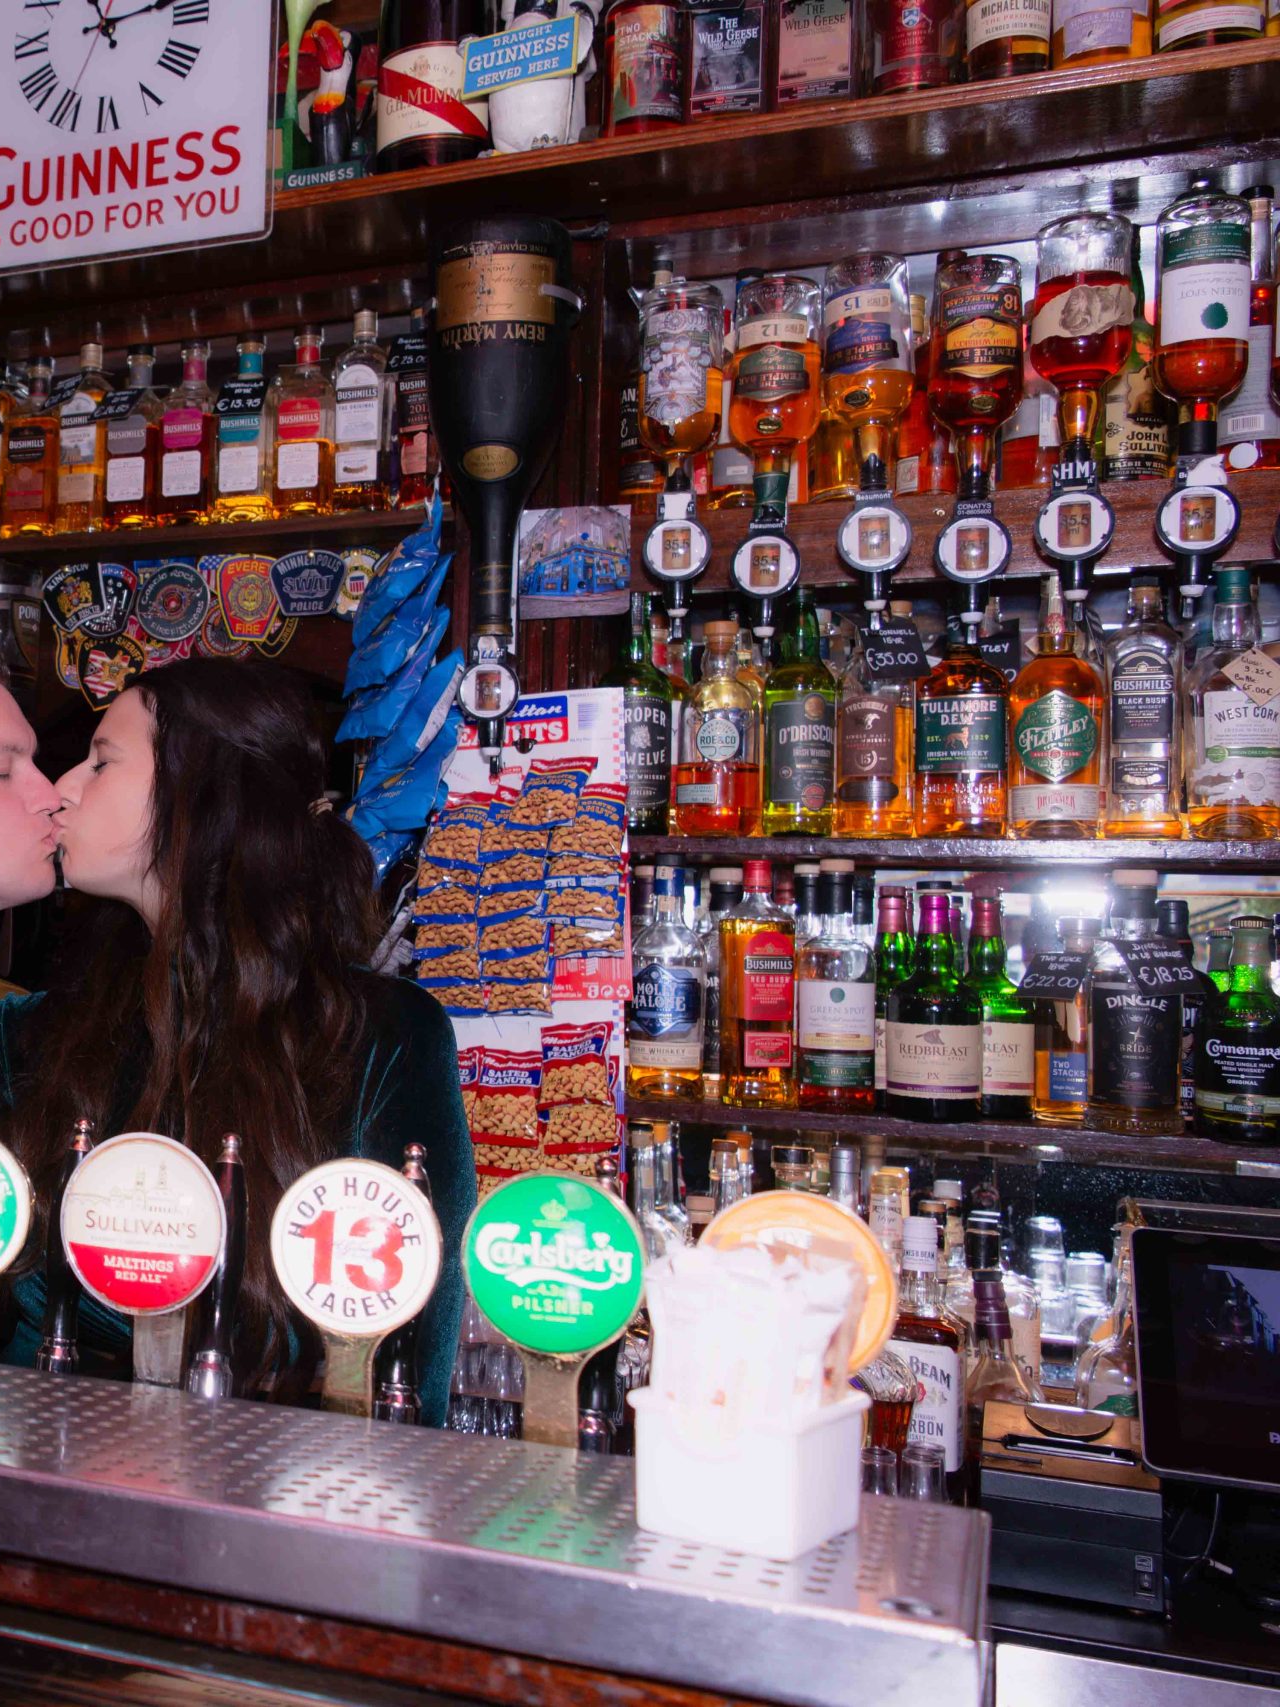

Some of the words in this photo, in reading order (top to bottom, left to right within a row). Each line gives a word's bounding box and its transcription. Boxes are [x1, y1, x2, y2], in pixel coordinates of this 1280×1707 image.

[981, 0, 1020, 18] MICHAEL
[718, 16, 739, 30] THE
[784, 17, 811, 31] WILD
[813, 13, 846, 28] GEESE
[492, 24, 554, 48] DRAUGHT
[619, 24, 640, 35] TWO
[698, 31, 724, 45] WILD
[727, 26, 760, 41] GEESE
[619, 31, 661, 47] STACKS
[468, 32, 570, 73] GUINNESS
[476, 67, 522, 87] SERVED
[528, 58, 560, 75] HERE
[288, 168, 354, 187] GUINNESS
[9, 210, 94, 246] GOOD
[104, 198, 164, 233] FOR
[174, 185, 241, 221] YOU
[843, 297, 862, 310] 15
[1003, 294, 1019, 312] 18
[761, 323, 780, 337] 12
[400, 380, 426, 391] BUSHM
[337, 388, 377, 400] BUSHMILLS
[220, 417, 259, 428] BUSHMILLS
[279, 413, 319, 424] BUSHMILLS
[108, 428, 145, 440] BUSHMILLS
[163, 421, 202, 434] BUSHMILLS
[1127, 431, 1159, 441] JOHN
[9, 440, 45, 450] BUSHMILLS
[855, 492, 892, 501] Beaumont
[957, 502, 992, 511] CONATYS
[749, 521, 785, 531] Beaumont
[276, 554, 341, 575] MINNEAPOLIS
[752, 556, 779, 567] 35.5
[290, 601, 324, 611] POLICE
[235, 624, 261, 635] FIRE
[866, 647, 918, 671] €35.00
[1113, 680, 1172, 691] BUSHMILLS
[921, 700, 997, 714] TULLAMORE
[1118, 697, 1143, 705] BLACK
[1145, 697, 1166, 705] BUSH
[624, 707, 666, 727] ROPER
[1214, 707, 1248, 723] WEST
[1253, 706, 1279, 723] CORK
[927, 735, 942, 743] EST.
[1020, 716, 1088, 754] FLATLEY
[625, 748, 666, 766] WELVE
[746, 959, 793, 970] BUSHMILLS
[1023, 974, 1079, 988] €22.00
[1138, 966, 1194, 986] €18.25
[636, 982, 676, 997] MOLLY
[631, 996, 686, 1012] MALONE
[809, 1005, 842, 1015] GREEN
[843, 1005, 866, 1015] SPOT
[1105, 994, 1168, 1012] DINGLE
[547, 1045, 596, 1058] PEANUTS
[552, 1040, 592, 1051] SALTED
[649, 1047, 686, 1055] WHISKEY
[899, 1042, 970, 1057] REDBREAST
[1206, 1039, 1280, 1060] Connemara
[926, 1071, 940, 1080] PX
[1053, 1068, 1086, 1077] STACKS
[482, 1076, 532, 1085] PEANUTS
[288, 1185, 327, 1238] HOP
[344, 1177, 421, 1247] HOUSE
[86, 1209, 197, 1239] SULLIVAN'S
[300, 1210, 404, 1293] 13
[474, 1220, 634, 1290] Carlsberg
[103, 1255, 174, 1273] MALTINGS
[115, 1270, 135, 1283] RED
[305, 1282, 397, 1318] LAGER
[512, 1296, 594, 1315] PILSNER
[909, 1355, 952, 1390] BEAM
[908, 1420, 944, 1437] RBON
